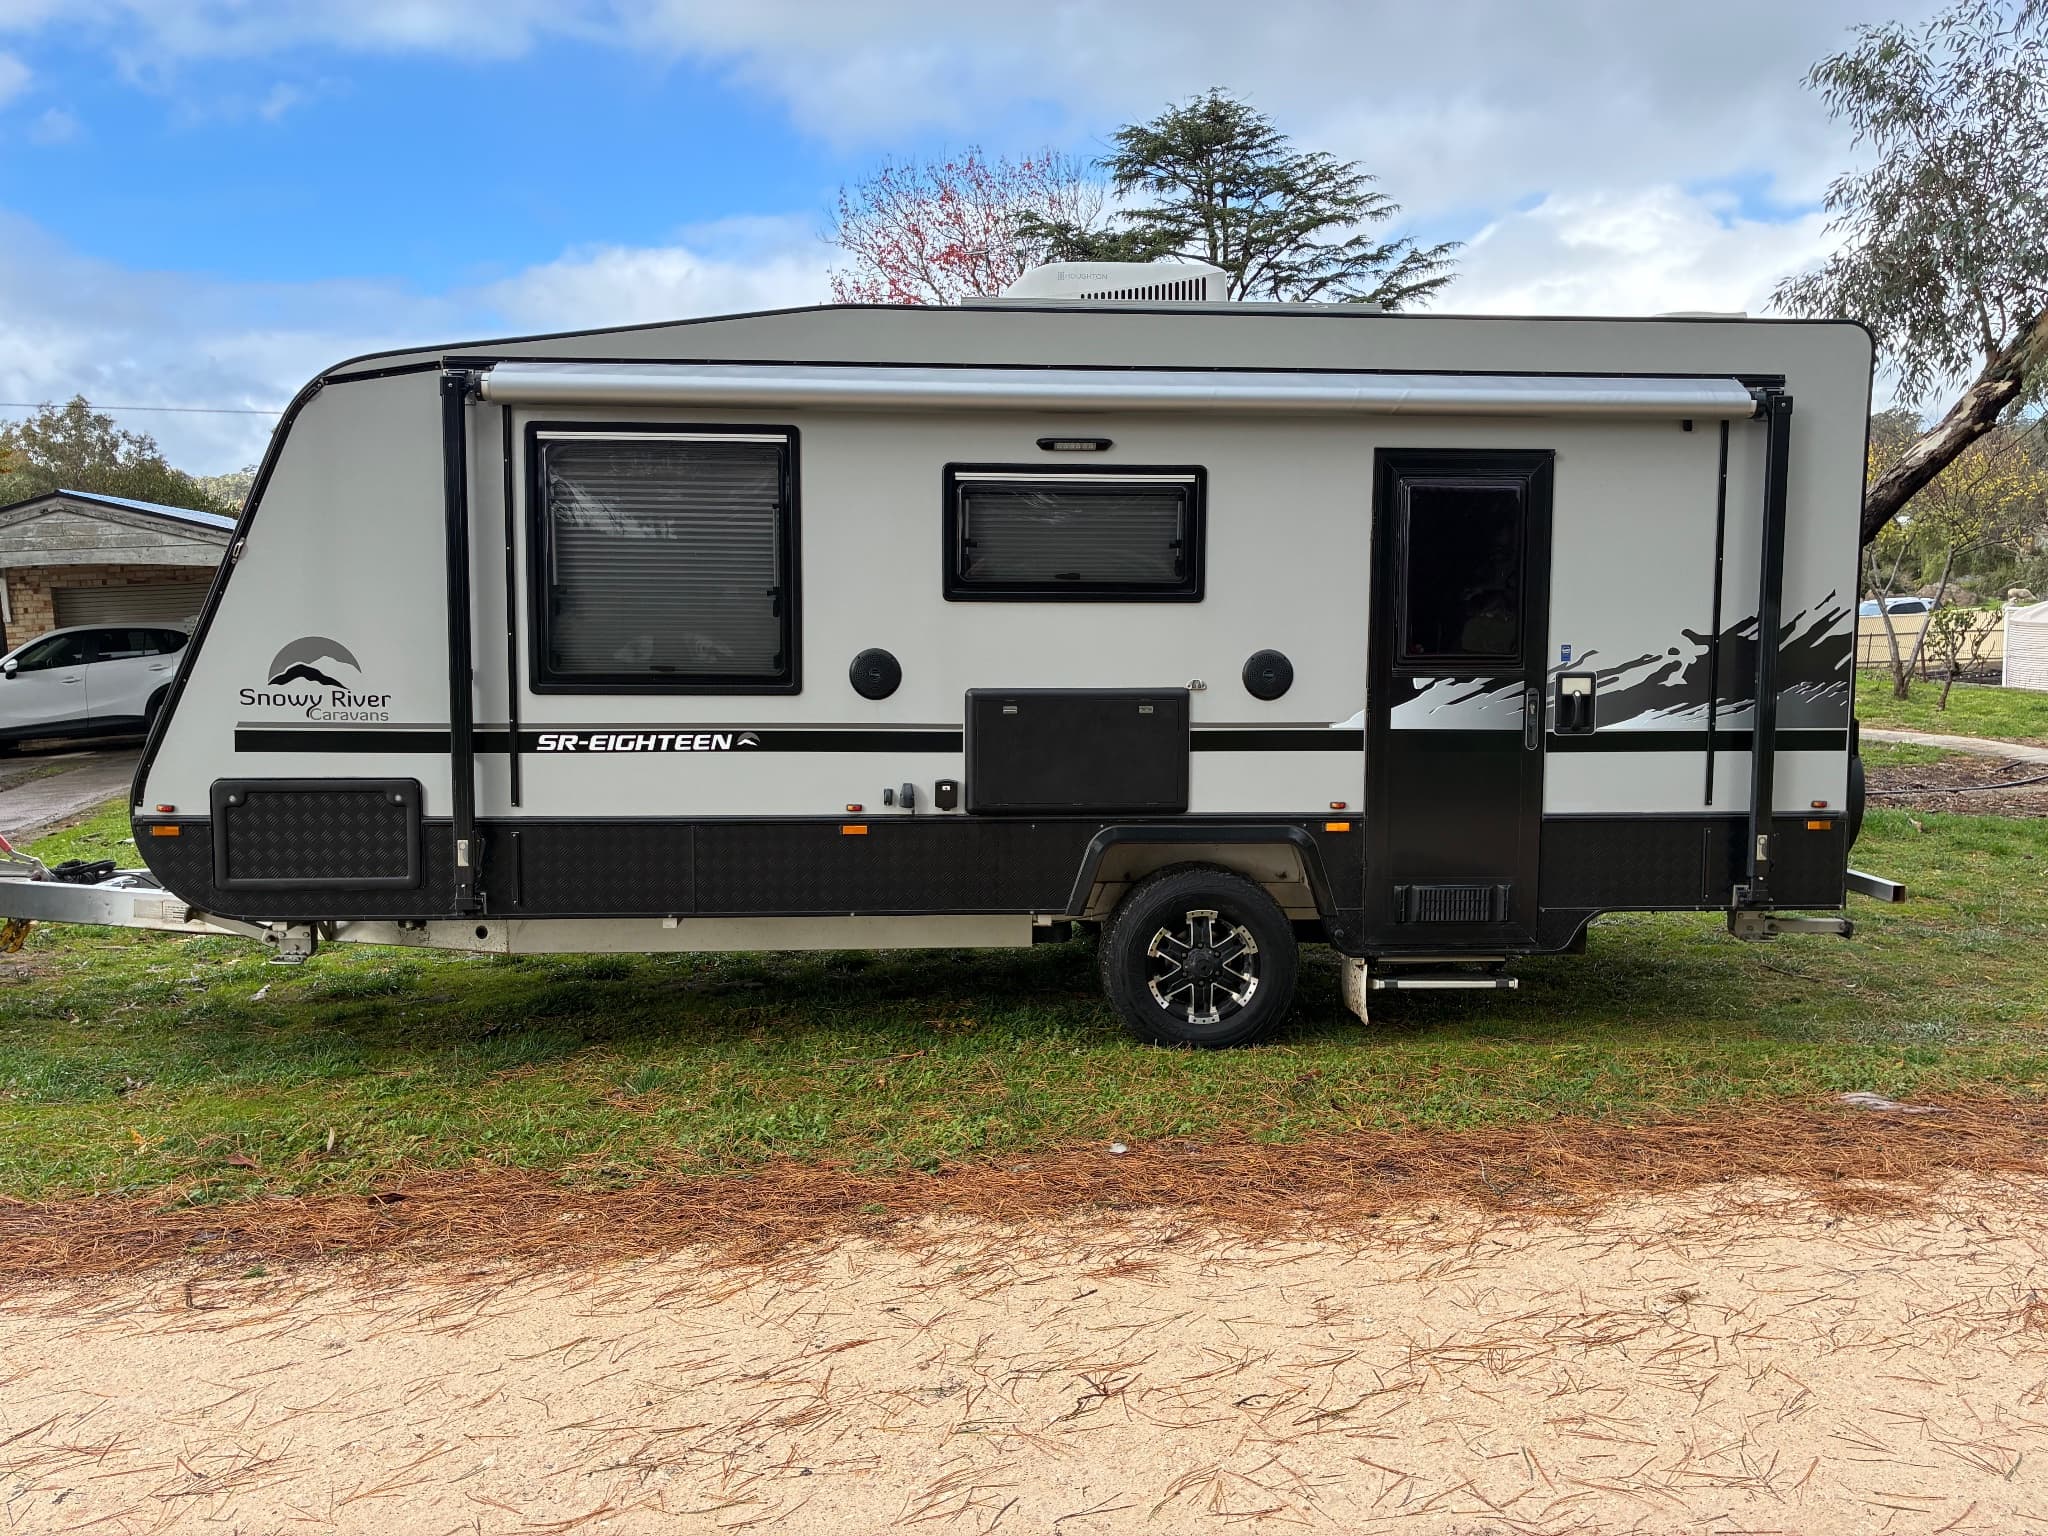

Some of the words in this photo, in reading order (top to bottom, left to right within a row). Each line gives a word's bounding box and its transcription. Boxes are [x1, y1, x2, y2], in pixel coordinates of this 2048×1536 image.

[239, 688, 323, 718] Snowy
[332, 690, 392, 708] River
[310, 708, 390, 721] Caravans
[536, 733, 733, 751] SR-EIGHTEEN
